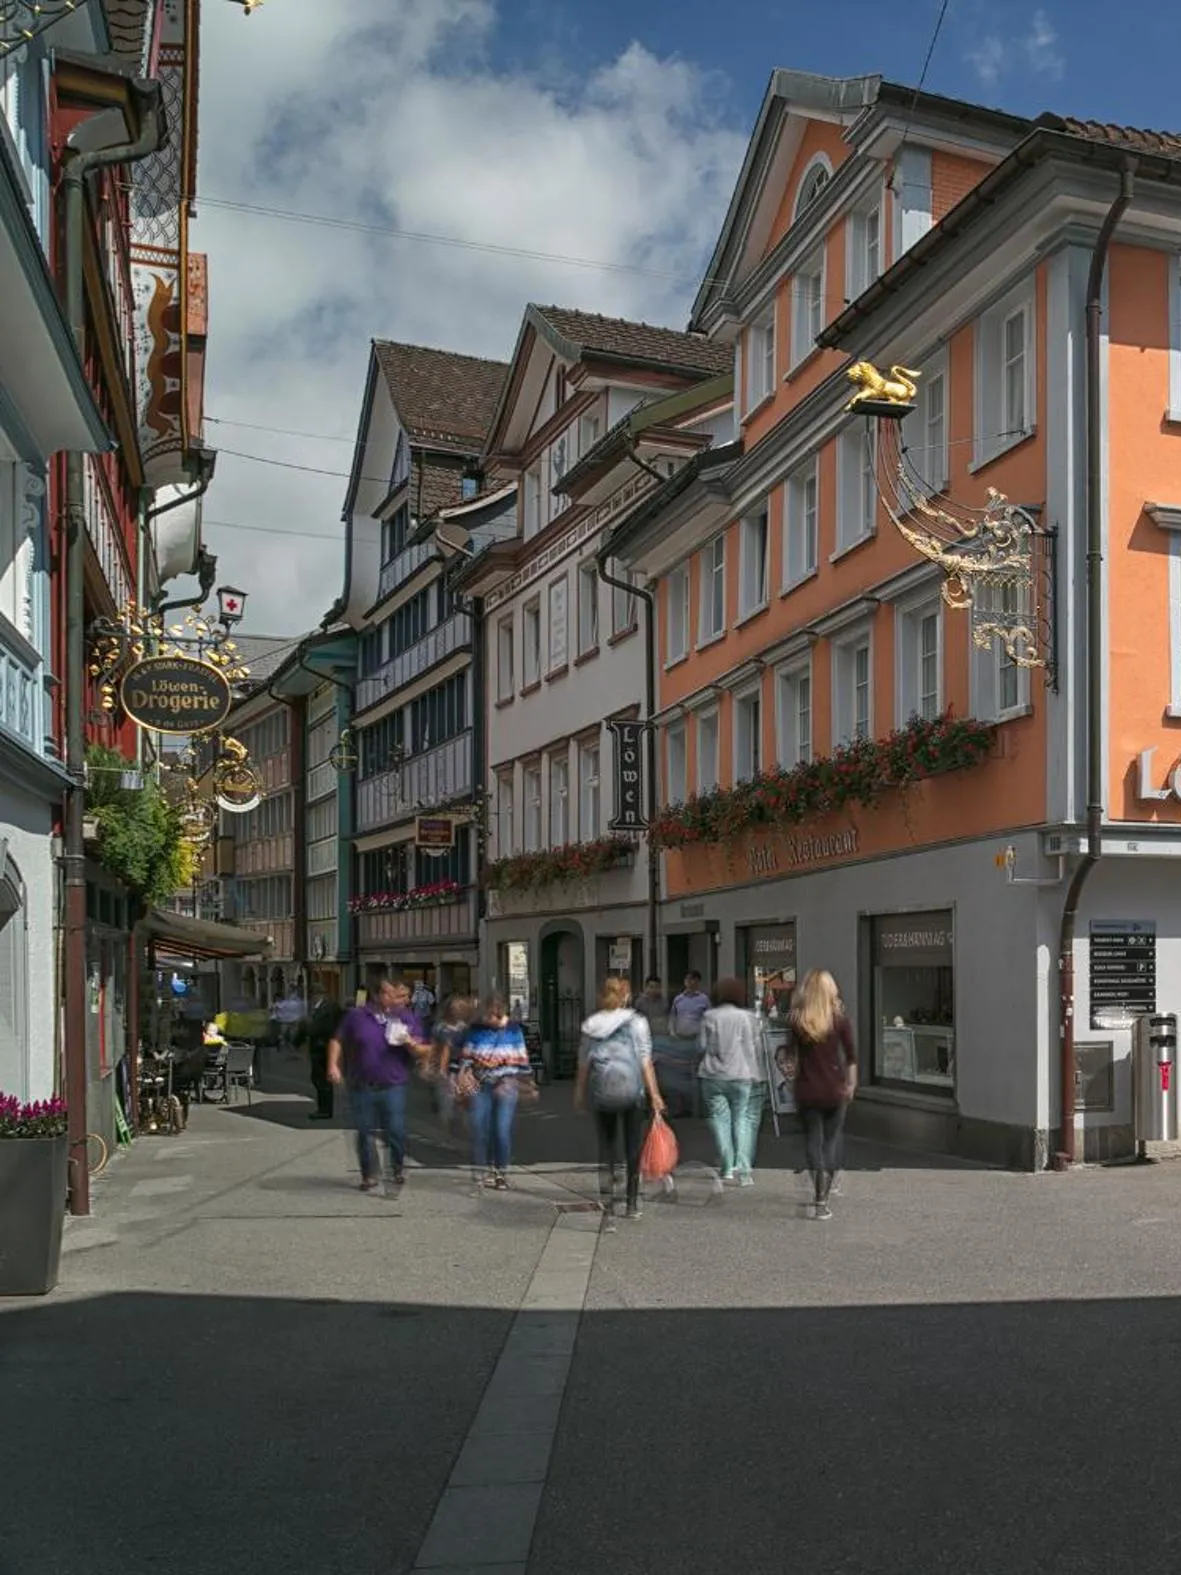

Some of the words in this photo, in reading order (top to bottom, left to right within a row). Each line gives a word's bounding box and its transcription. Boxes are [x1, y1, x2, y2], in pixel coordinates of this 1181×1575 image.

[151, 679, 206, 693] Löwen-
[131, 689, 220, 714] Drogerie
[622, 726, 639, 824] Löwen
